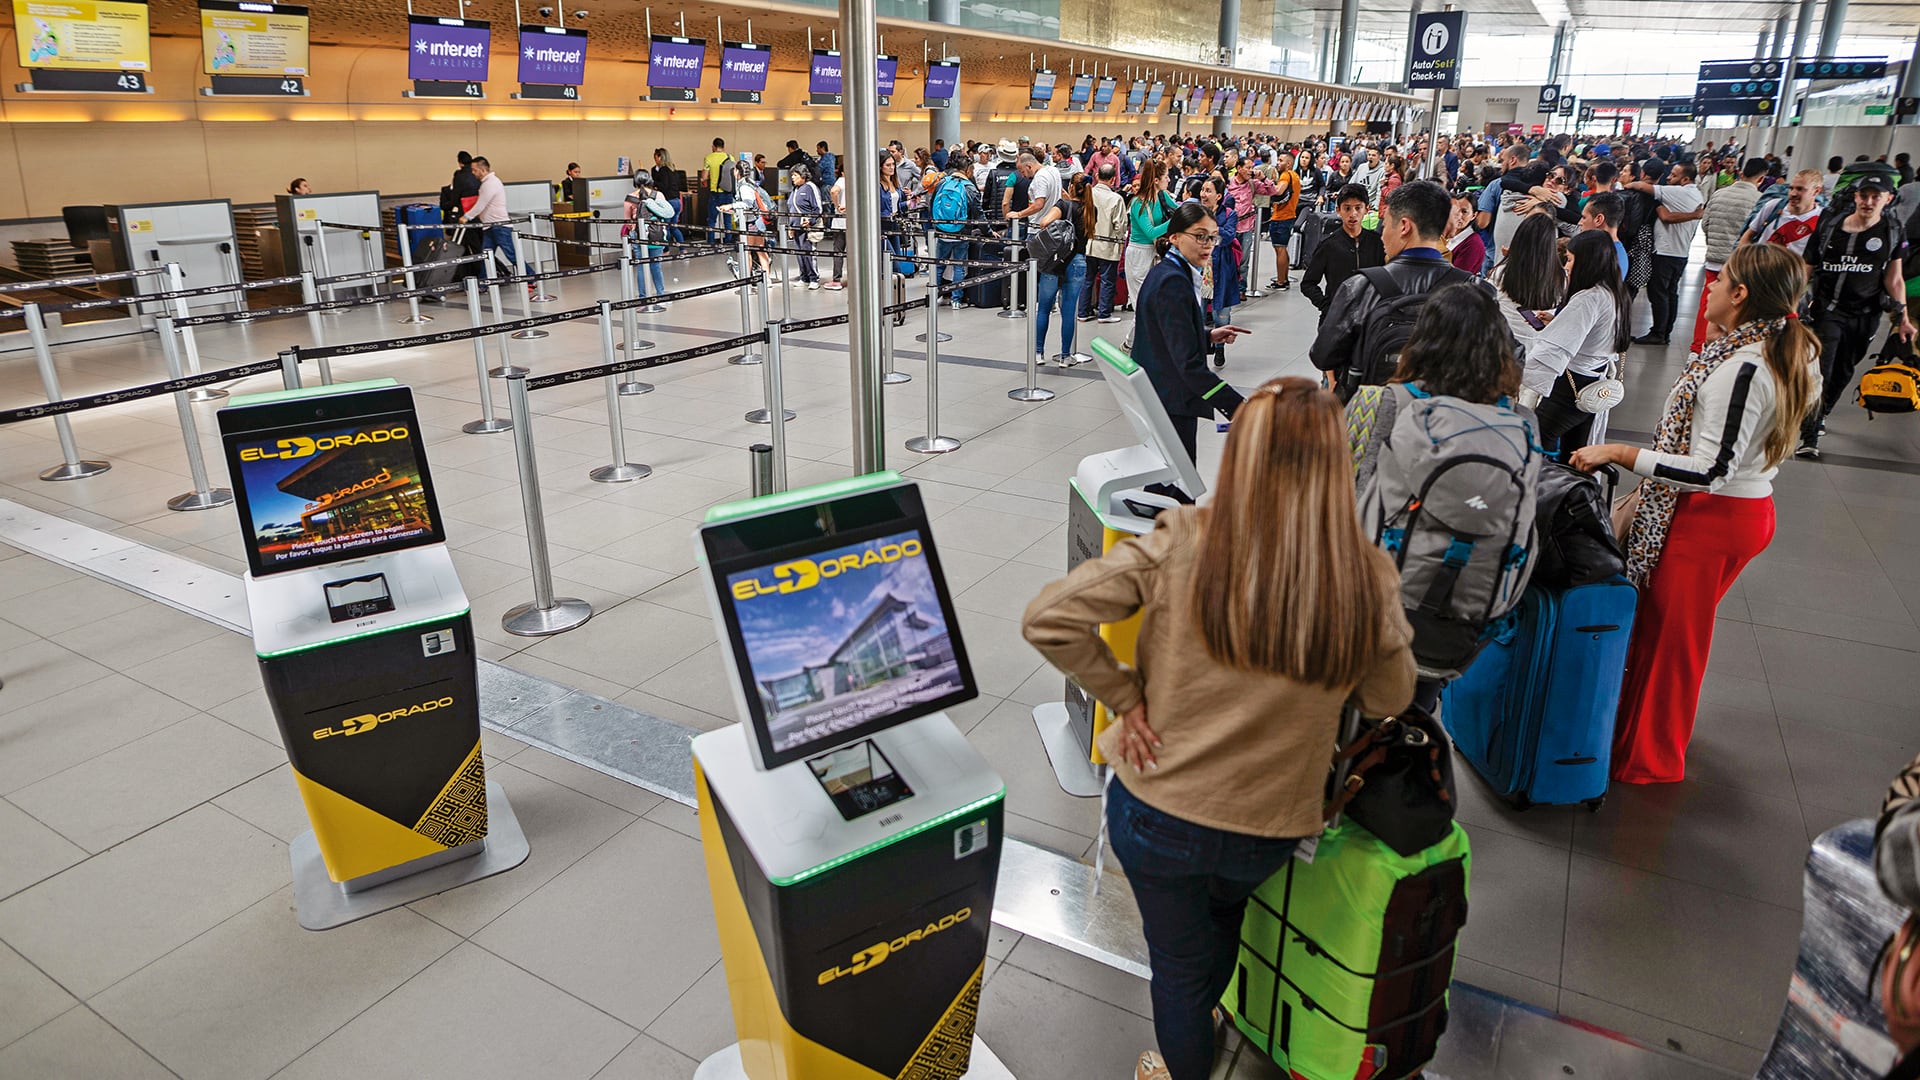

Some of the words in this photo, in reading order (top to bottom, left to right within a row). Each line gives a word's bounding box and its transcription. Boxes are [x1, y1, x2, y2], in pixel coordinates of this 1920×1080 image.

[430, 58, 484, 68] AIRLINES
[536, 63, 580, 73] AIRLINES
[662, 69, 698, 78] AIRLINES
[1411, 72, 1446, 80] Check-in
[118, 75, 140, 89] 43
[281, 80, 300, 92] 42
[465, 84, 480, 96] 41
[564, 88, 576, 98] 40
[684, 90, 694, 99] 39
[750, 93, 759, 102] 38
[1840, 256, 1858, 264] Fly
[1822, 261, 1874, 272] Emirates
[292, 540, 314, 550] Please
[316, 537, 336, 546] touch
[351, 530, 374, 540] screen
[384, 524, 405, 534] begin!
[276, 551, 288, 560] Por
[290, 548, 311, 559] favor,
[312, 543, 332, 554] toque
[343, 537, 370, 550] pantalla
[372, 534, 388, 544] para
[388, 528, 423, 540] comenzar!
